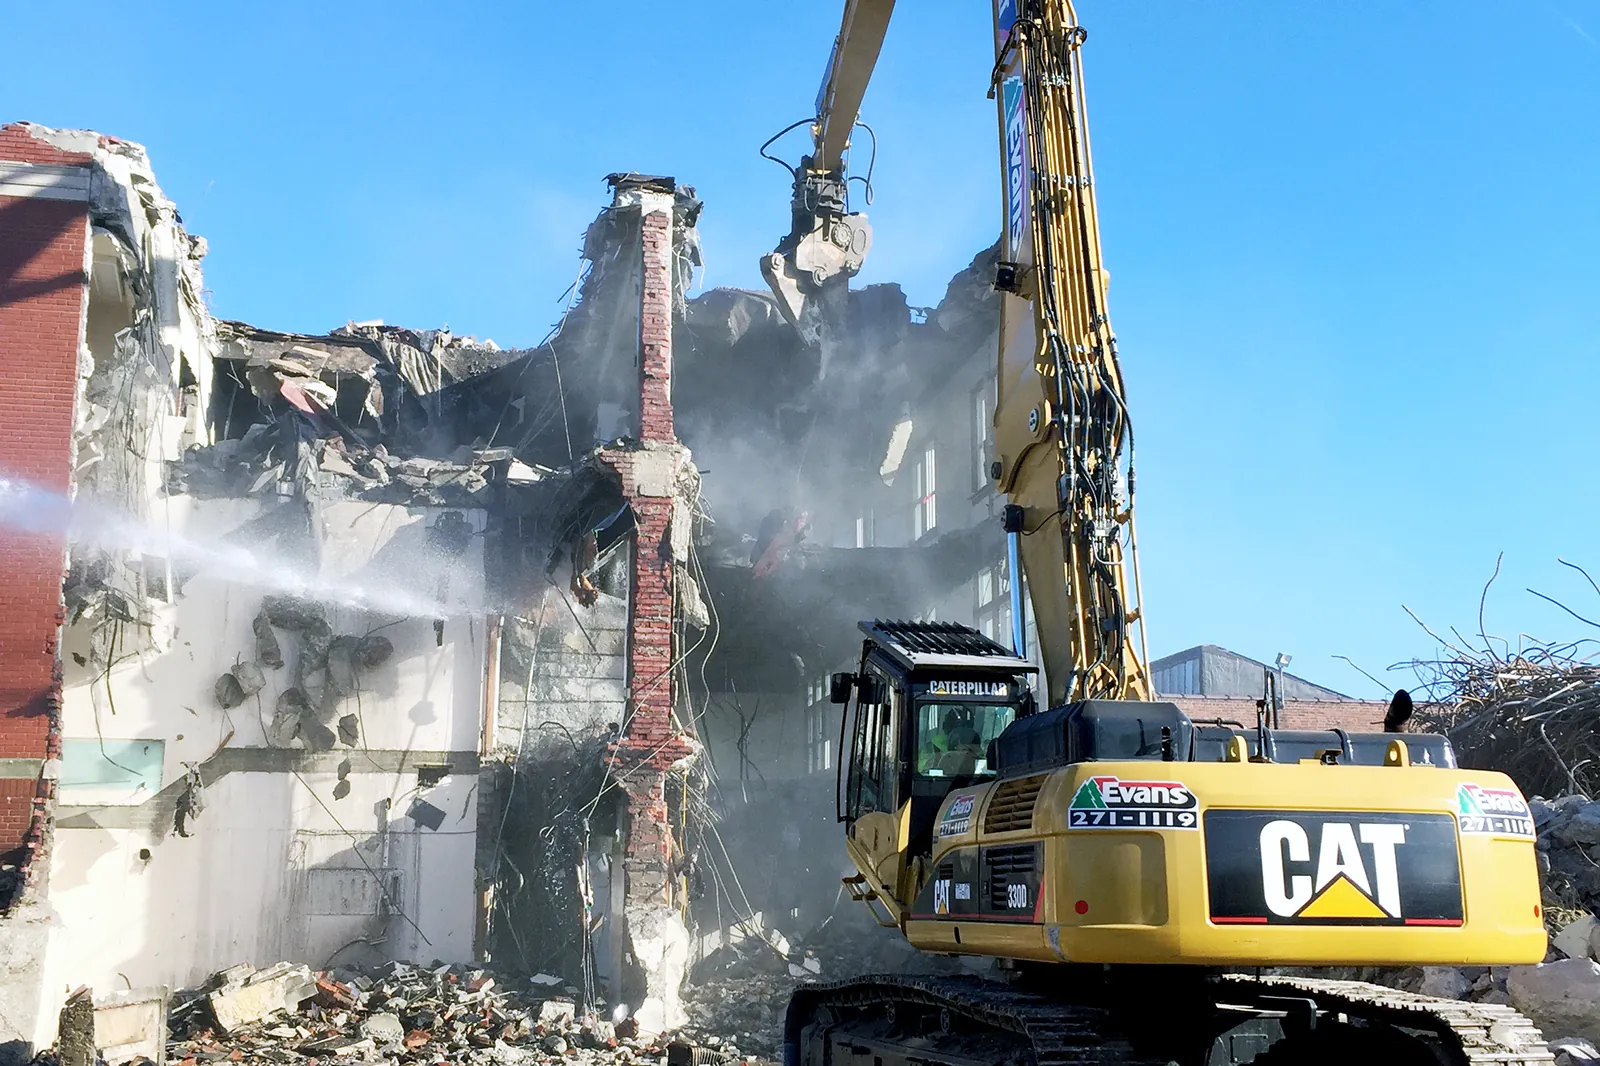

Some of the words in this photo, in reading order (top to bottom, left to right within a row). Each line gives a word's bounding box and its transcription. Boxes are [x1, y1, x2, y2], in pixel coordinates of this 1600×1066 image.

[1010, 114, 1023, 252] Evans
[930, 680, 1007, 696] CATERPILLAR
[1103, 782, 1188, 804] Evans
[1475, 789, 1526, 813] Evans
[950, 799, 974, 816] Evans
[940, 820, 969, 836] 271-1119
[1072, 811, 1196, 827] 271-1119
[1460, 817, 1533, 835] 271-1119
[1259, 820, 1406, 918] CAT
[934, 879, 950, 914] CAT
[1007, 884, 1027, 908] 330D
